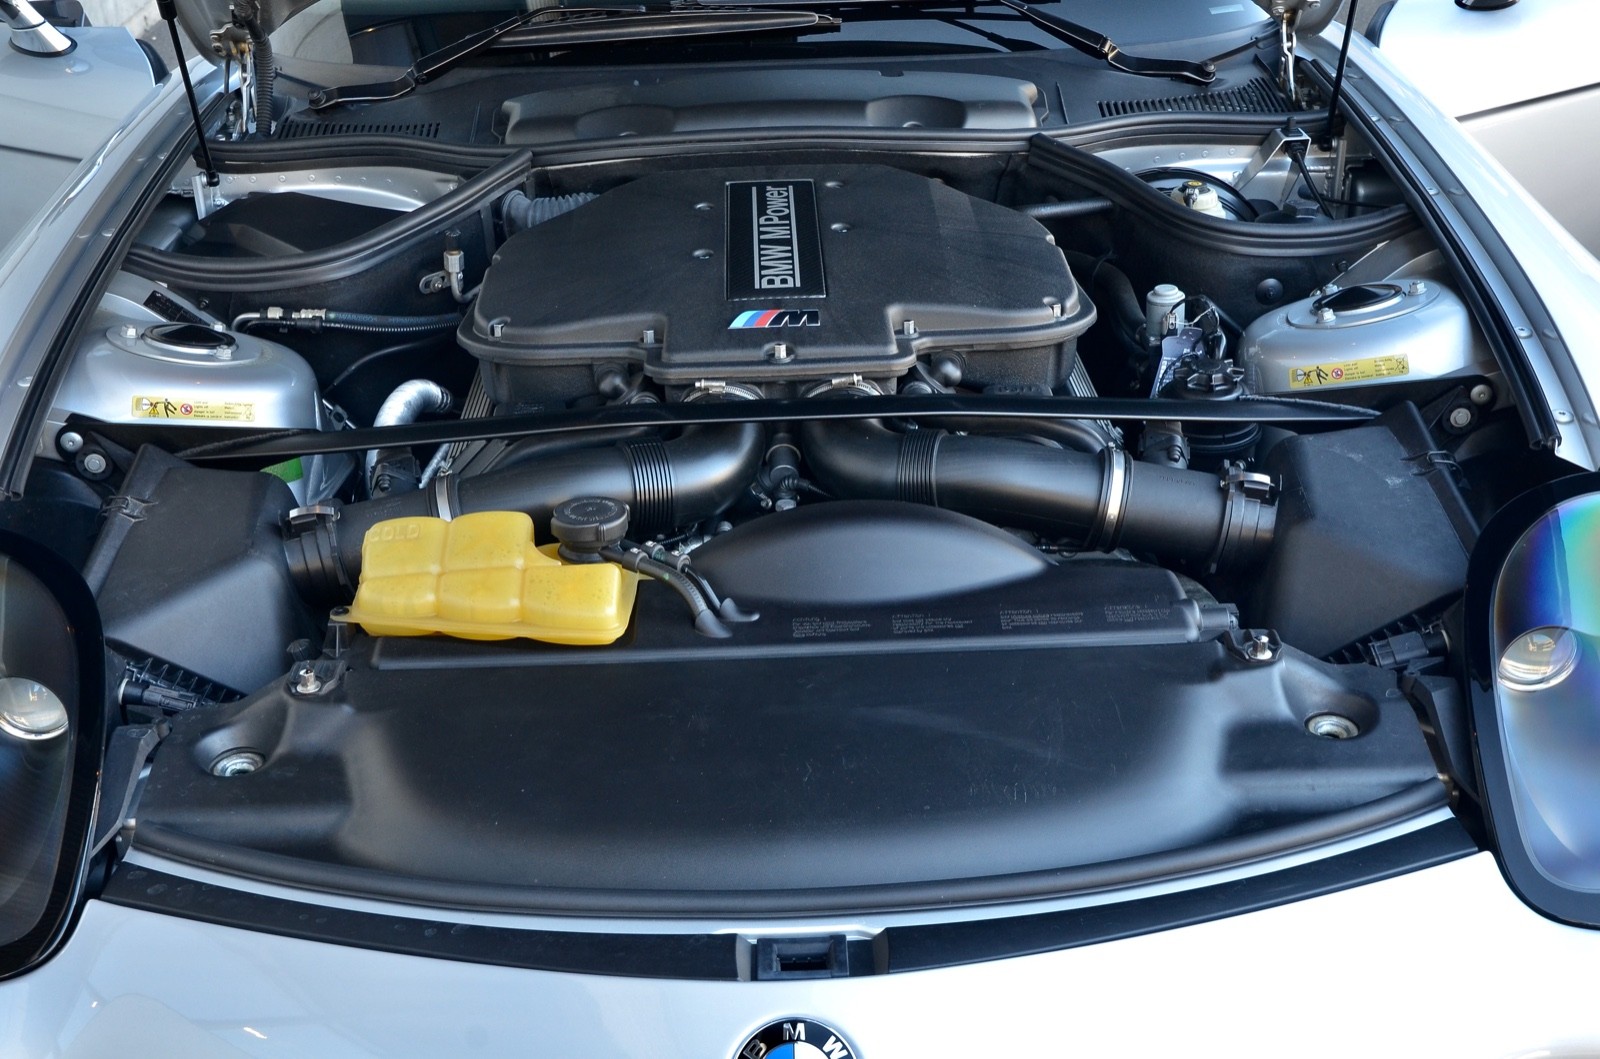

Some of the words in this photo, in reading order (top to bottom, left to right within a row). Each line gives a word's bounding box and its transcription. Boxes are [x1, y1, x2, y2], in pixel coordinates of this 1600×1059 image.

[761, 245, 794, 288] BMW
[369, 523, 422, 542] COLD
[743, 1022, 849, 1059] BMW
